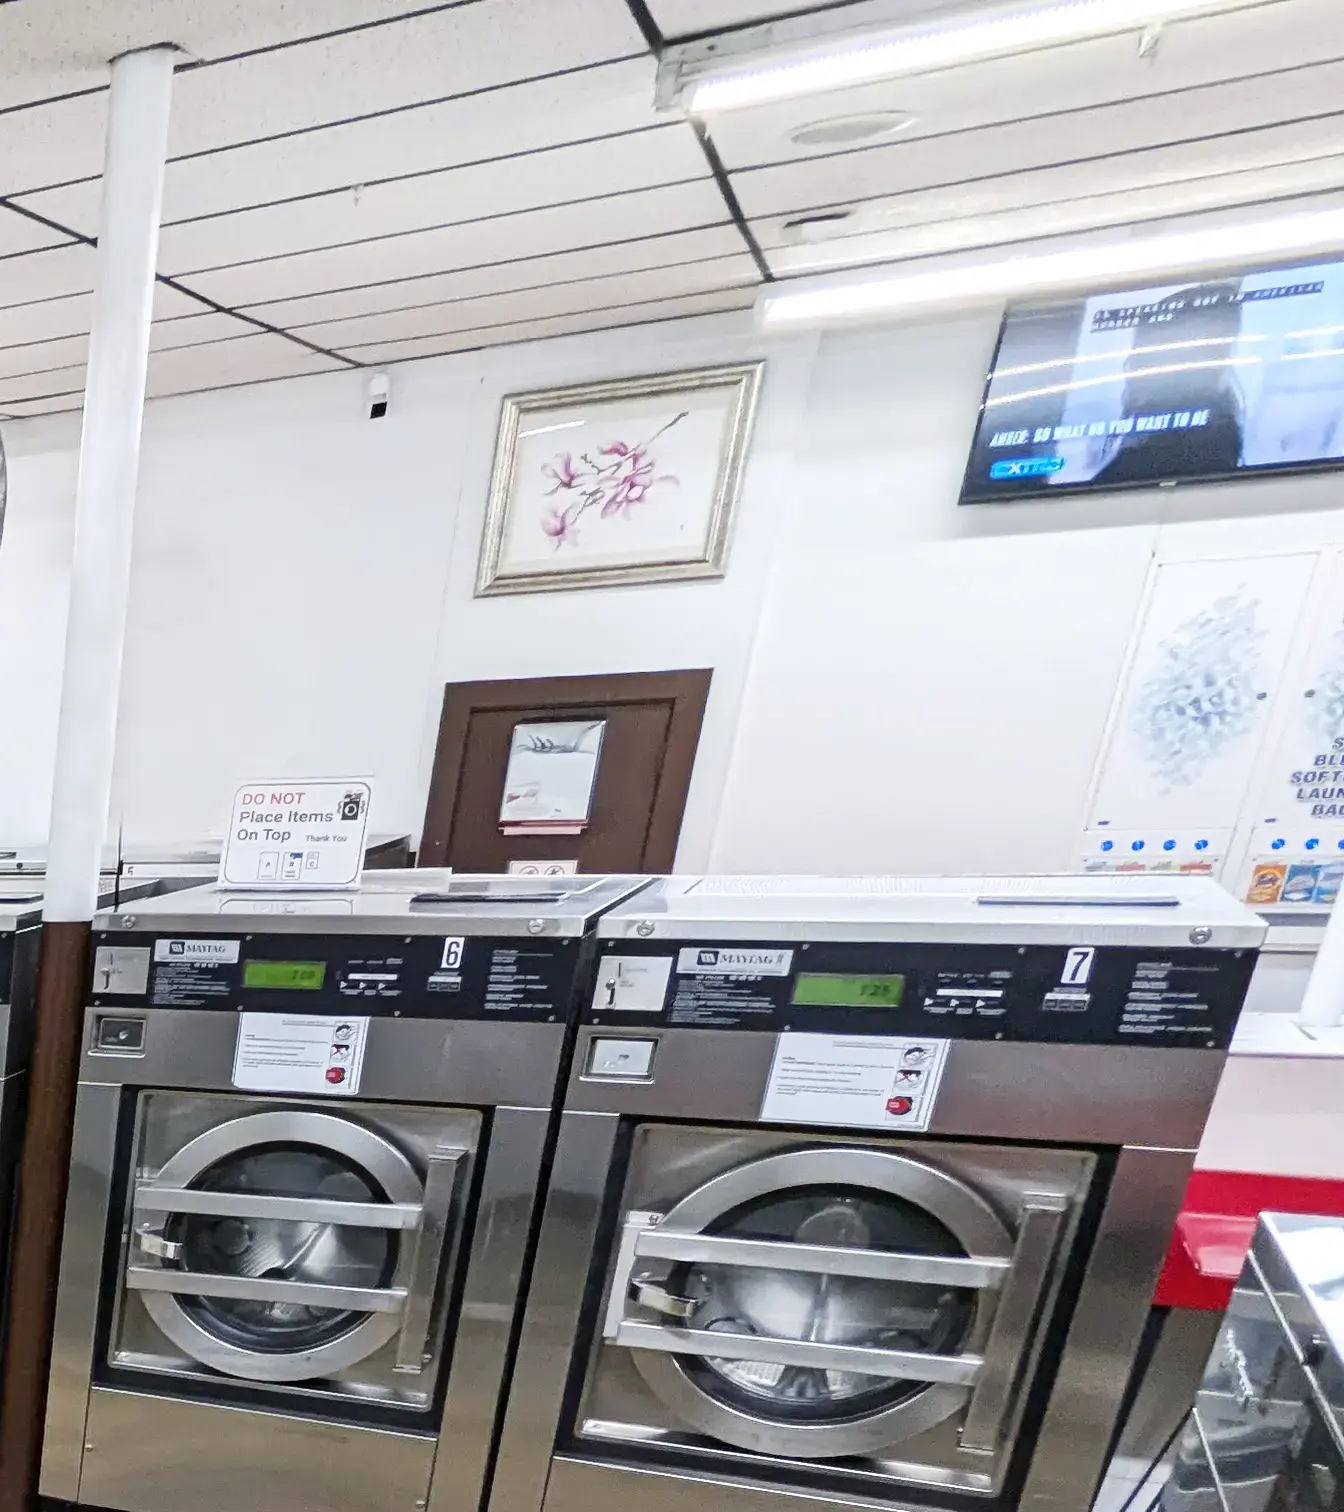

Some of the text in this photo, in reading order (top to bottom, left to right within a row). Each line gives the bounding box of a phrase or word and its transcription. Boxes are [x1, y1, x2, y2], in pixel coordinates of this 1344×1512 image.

[1109, 418, 1134, 434] YOU
[1135, 414, 1172, 432] WANT
[1290, 771, 1344, 784] SOFT
[242, 792, 306, 806] DO NOT
[239, 810, 334, 823] Place Items
[237, 829, 291, 843] On Top
[186, 945, 226, 954] MAYTAG
[445, 941, 461, 967] 6
[719, 954, 773, 964] MAYTAG
[1069, 951, 1091, 982] 7
